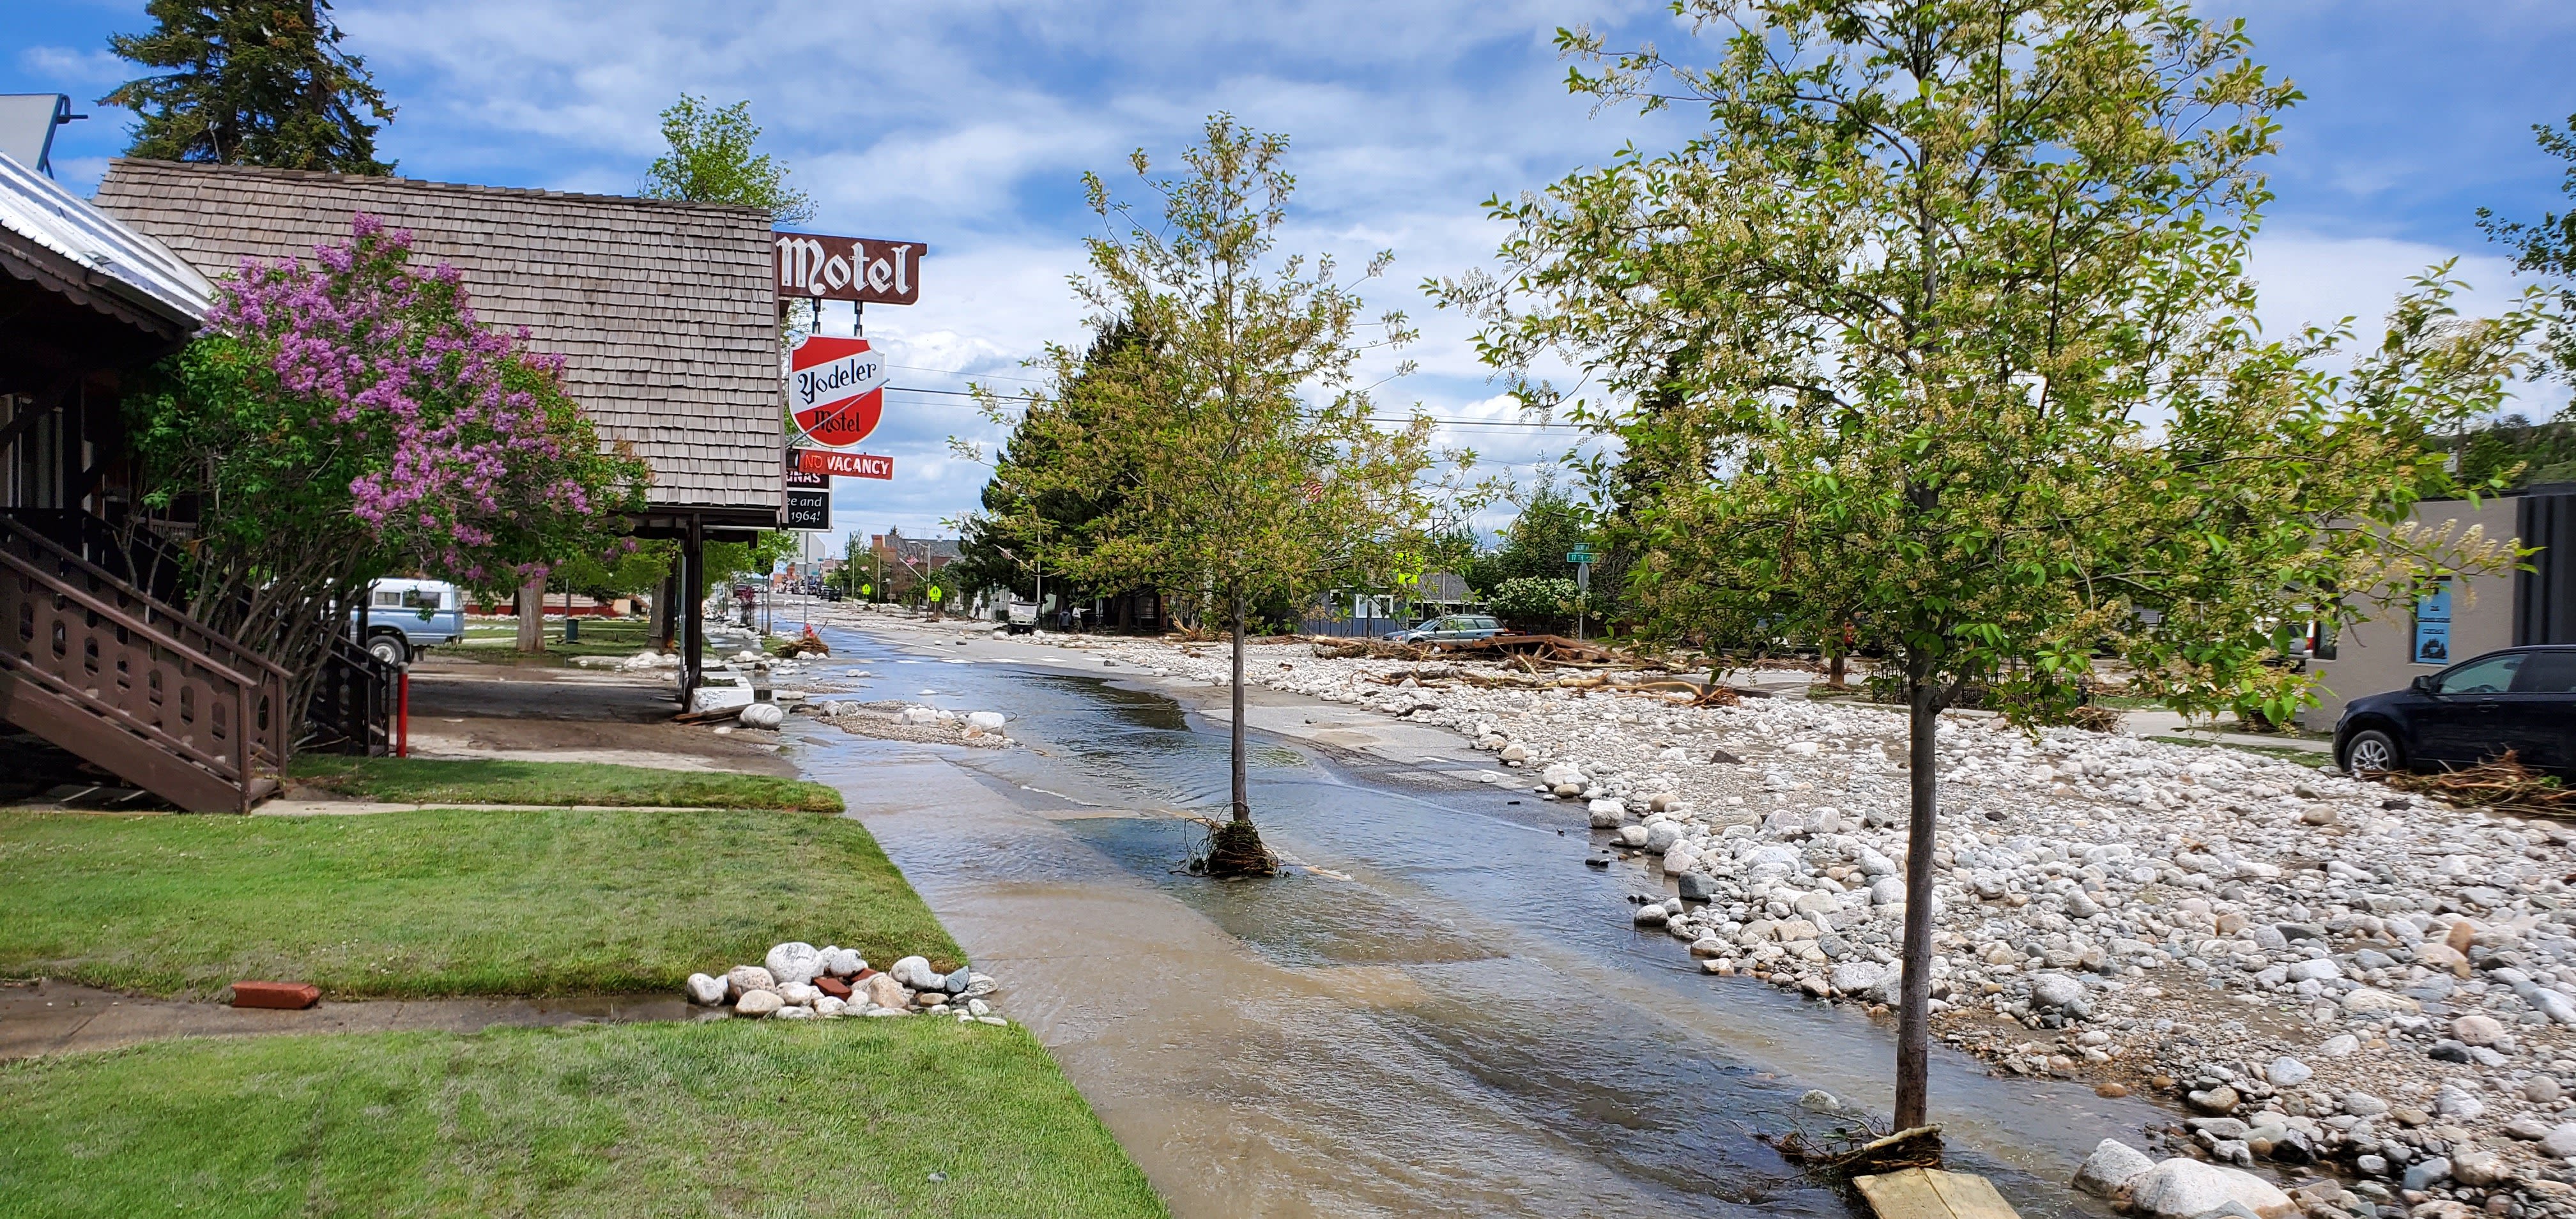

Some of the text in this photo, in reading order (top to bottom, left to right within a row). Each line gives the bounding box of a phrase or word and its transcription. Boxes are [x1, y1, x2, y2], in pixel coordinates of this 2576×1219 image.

[776, 236, 912, 296] Motel
[797, 358, 877, 405] Yodeler
[813, 410, 861, 433] Motel
[804, 454, 823, 469] NO
[827, 456, 890, 475] VACANCY
[800, 496, 822, 507] and
[790, 510, 821, 523] 1964!
